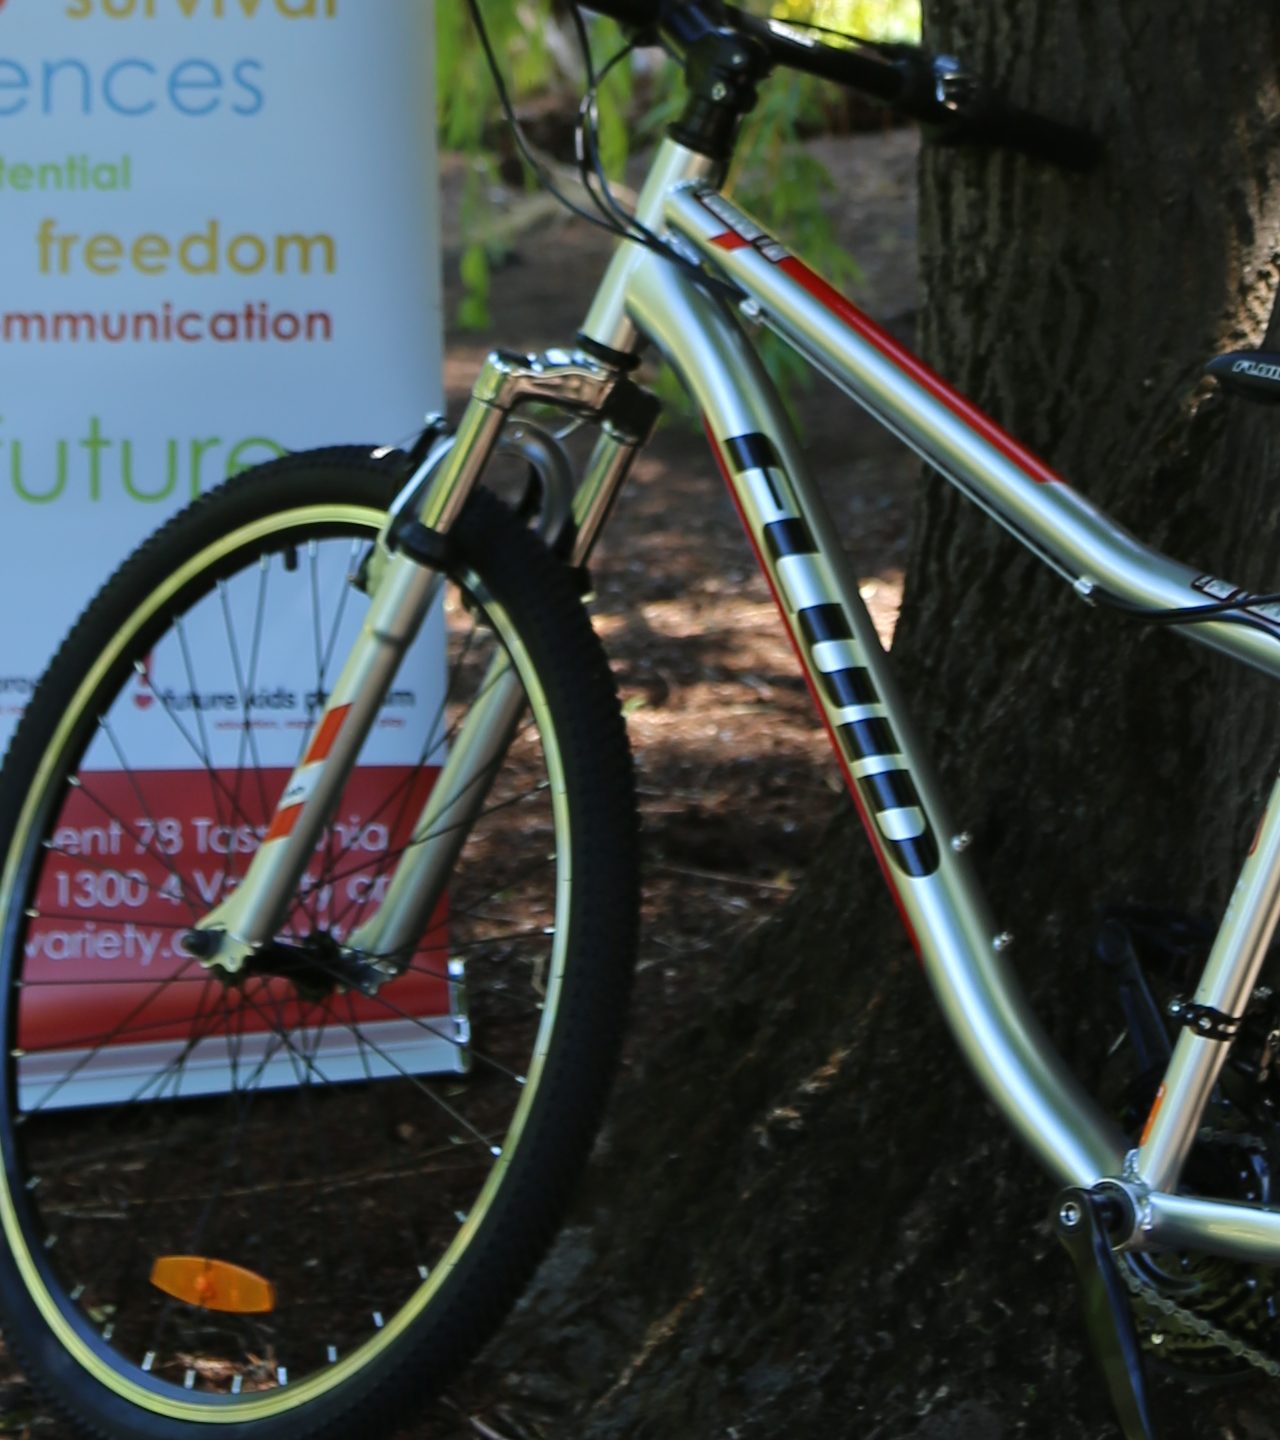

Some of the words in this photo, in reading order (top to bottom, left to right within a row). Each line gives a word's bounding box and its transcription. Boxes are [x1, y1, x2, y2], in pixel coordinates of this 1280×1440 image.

[37, 218, 336, 276] freedom
[135, 818, 182, 855] 78
[57, 870, 148, 908] 1300
[157, 869, 183, 903] 4
